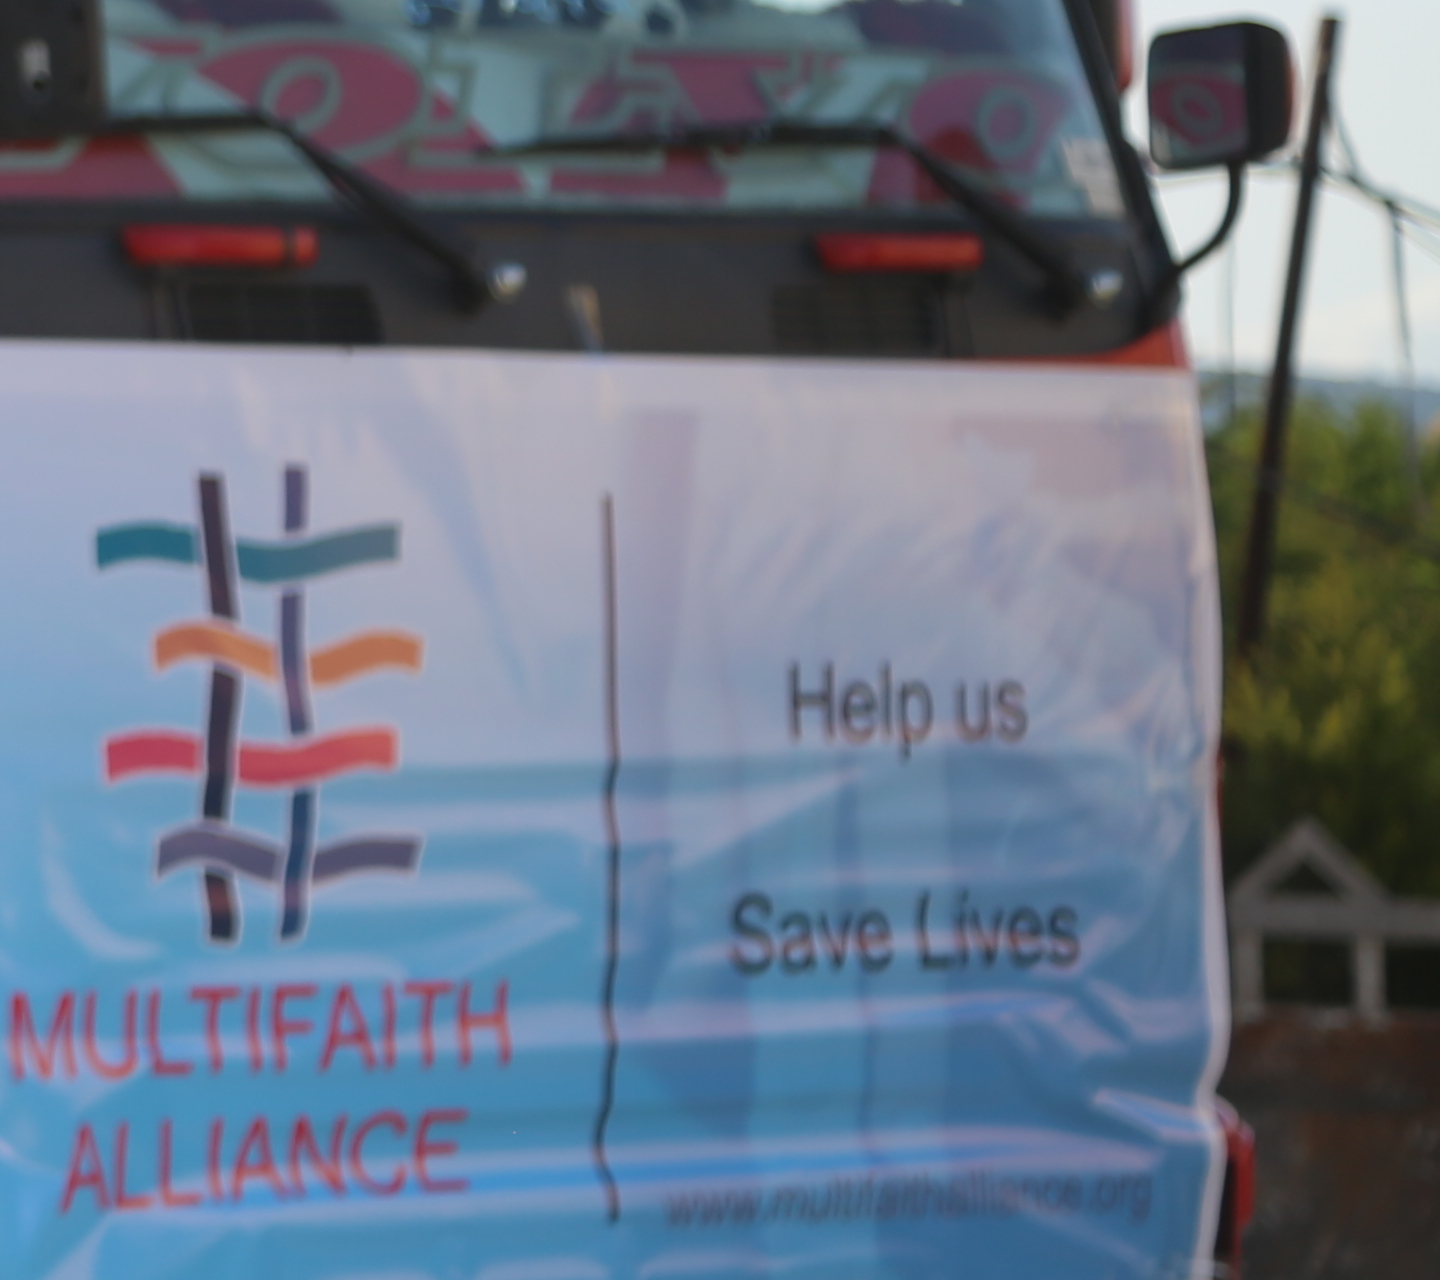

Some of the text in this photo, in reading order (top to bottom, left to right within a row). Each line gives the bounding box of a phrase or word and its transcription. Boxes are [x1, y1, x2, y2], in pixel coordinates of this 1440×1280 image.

[788, 659, 1030, 760] Help us
[728, 884, 1082, 978] Save Lives
[5, 976, 515, 1086] MULTIFAITH
[59, 1107, 471, 1216] ALLIANCE
